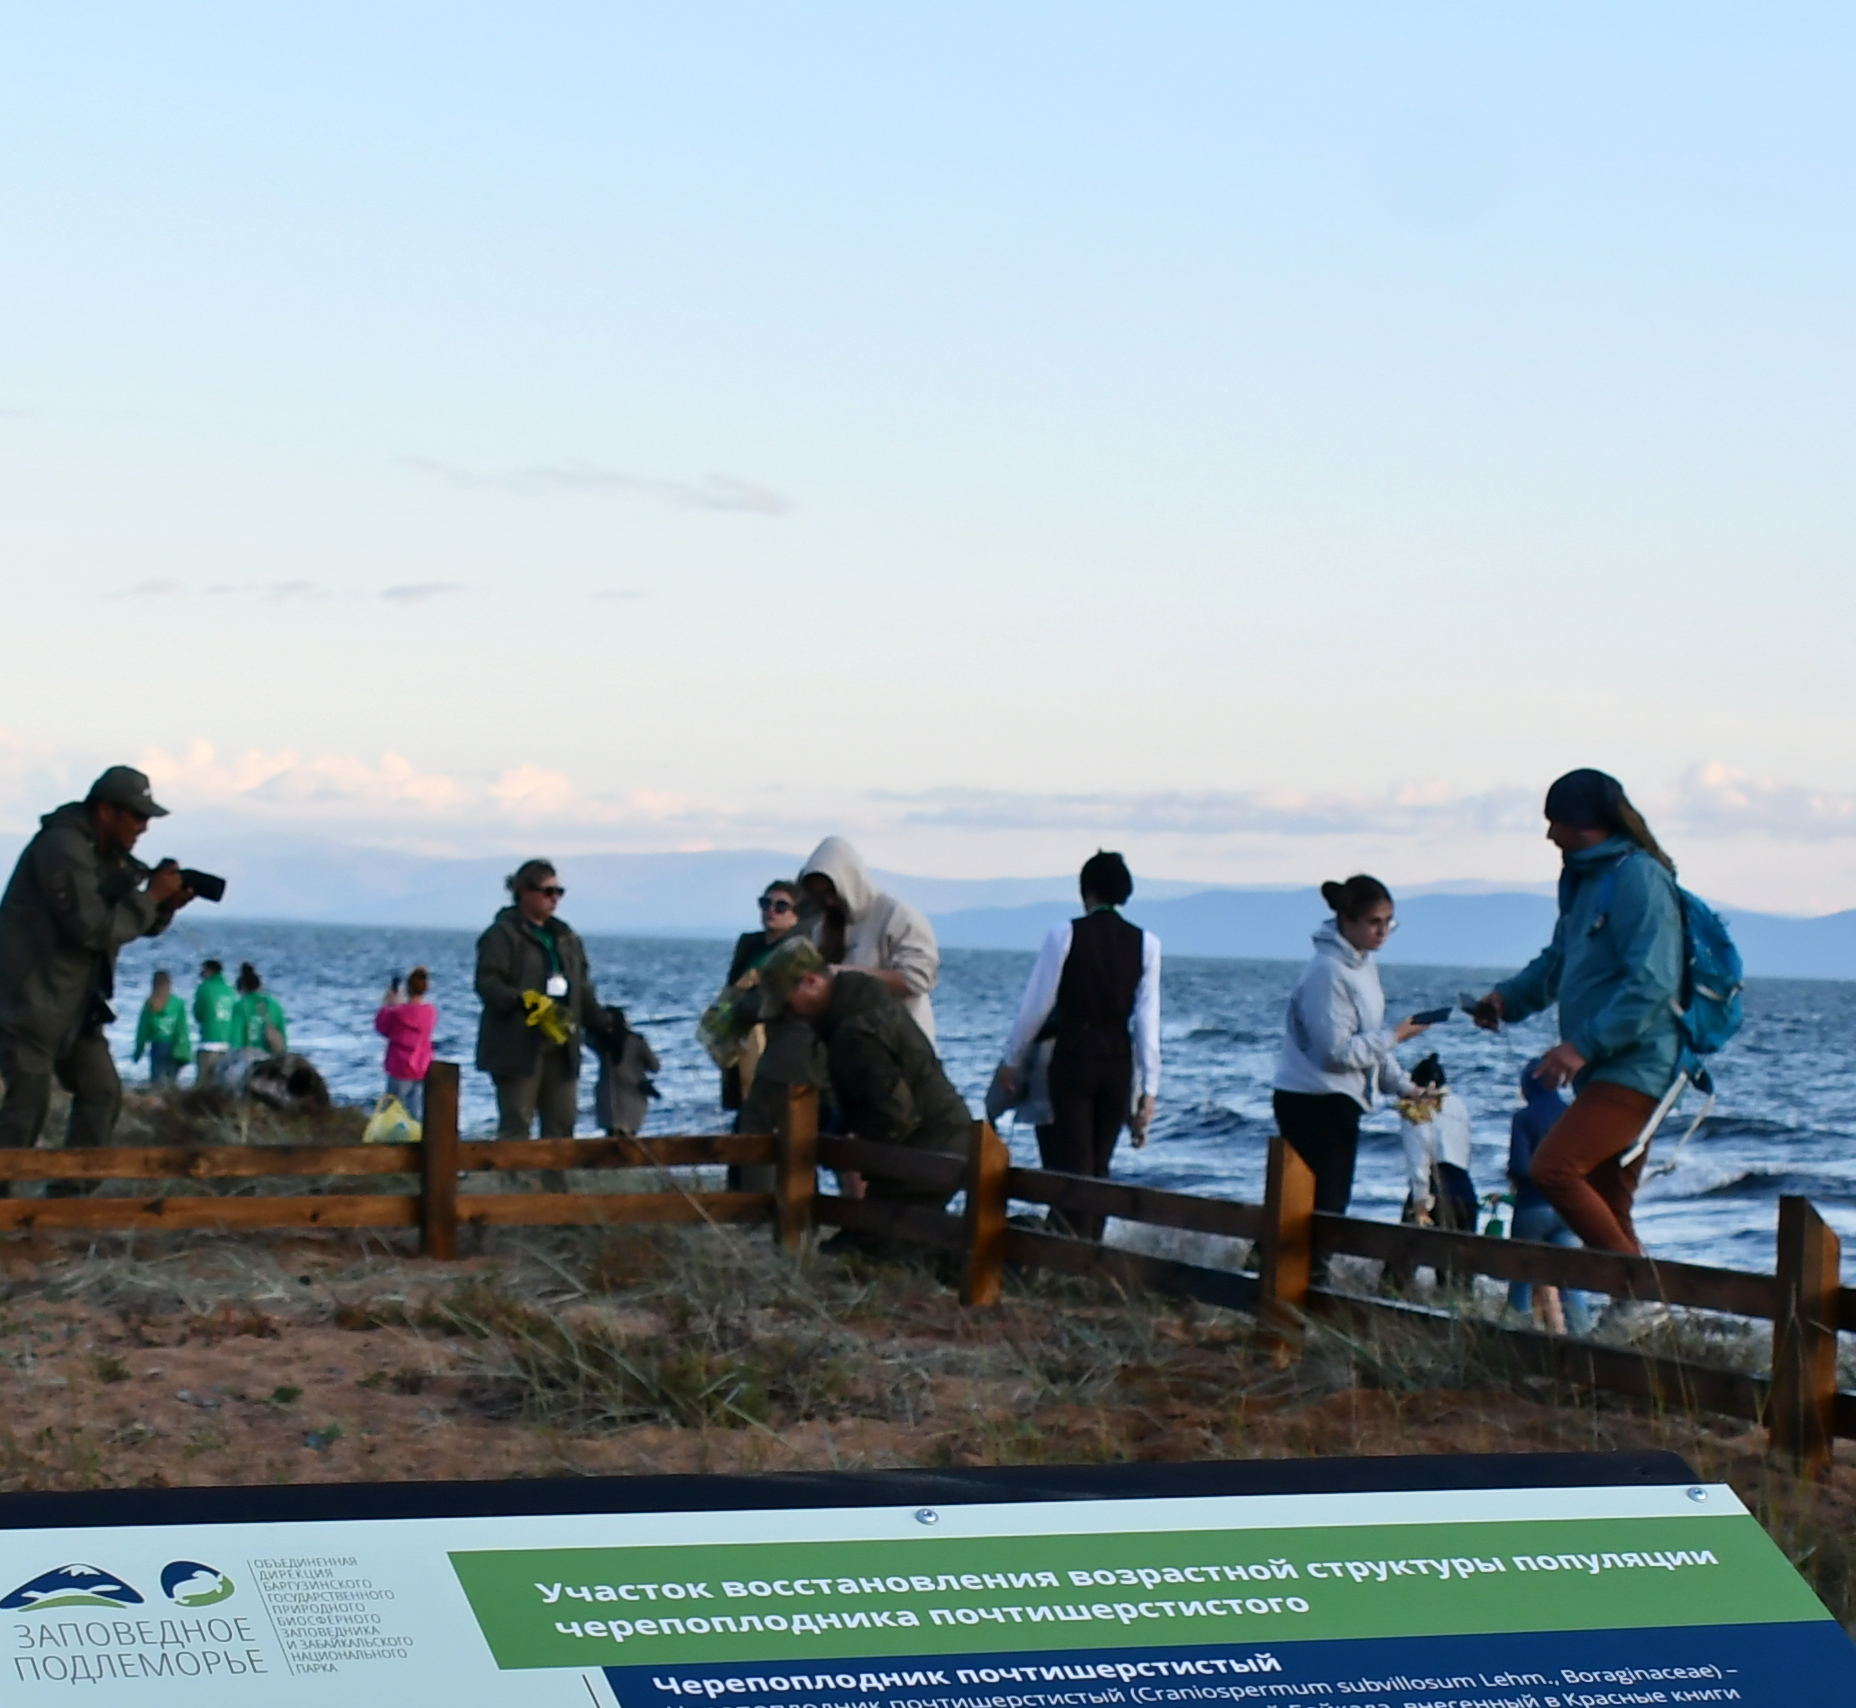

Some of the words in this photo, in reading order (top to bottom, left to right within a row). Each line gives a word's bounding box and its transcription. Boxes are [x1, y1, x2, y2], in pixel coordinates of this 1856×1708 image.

[253, 1557, 357, 1568] ОБЪЕДИНЕННАЯ
[259, 1568, 333, 1581] ДИРЕКЦИЯ
[533, 1581, 715, 1604] Участок
[720, 1570, 1061, 1598] восстановления
[1066, 1557, 1300, 1591] возрастной
[1305, 1556, 1508, 1584] структуры
[1510, 1549, 1720, 1576] популяции
[262, 1579, 372, 1591] БАРГУЗИНСКОГО
[267, 1589, 394, 1603] ГОСУДАРСТВЕННОГО
[271, 1602, 365, 1614] ПРИРОДНОГО
[276, 1613, 381, 1626] БИОСФЕРНОГО
[553, 1609, 921, 1644] черепоплодника
[927, 1596, 1311, 1627] почтишерстистого
[13, 1616, 257, 1651] ЗАПОВЕДНОЕ
[280, 1625, 382, 1640] ЗАПОВЕДНИКА
[300, 1636, 413, 1649] ЗАБАЙКАЛЬСКОГО
[290, 1648, 407, 1662] НАЦИОНАЛЬНОГО
[13, 1648, 270, 1687] ПОДЛЕМОРЬЕ
[295, 1663, 338, 1673] ПАРКА
[651, 1669, 952, 1700] Черепоплодник
[955, 1651, 1283, 1685] почтишерстистый
[1129, 1681, 1334, 1706] (Craniospermum
[1335, 1674, 1478, 1694] subvillosum
[1477, 1670, 1561, 1688] Lehm.,
[1559, 1663, 1723, 1686] Boraginaceae)
[1669, 1687, 1742, 1703] книги
